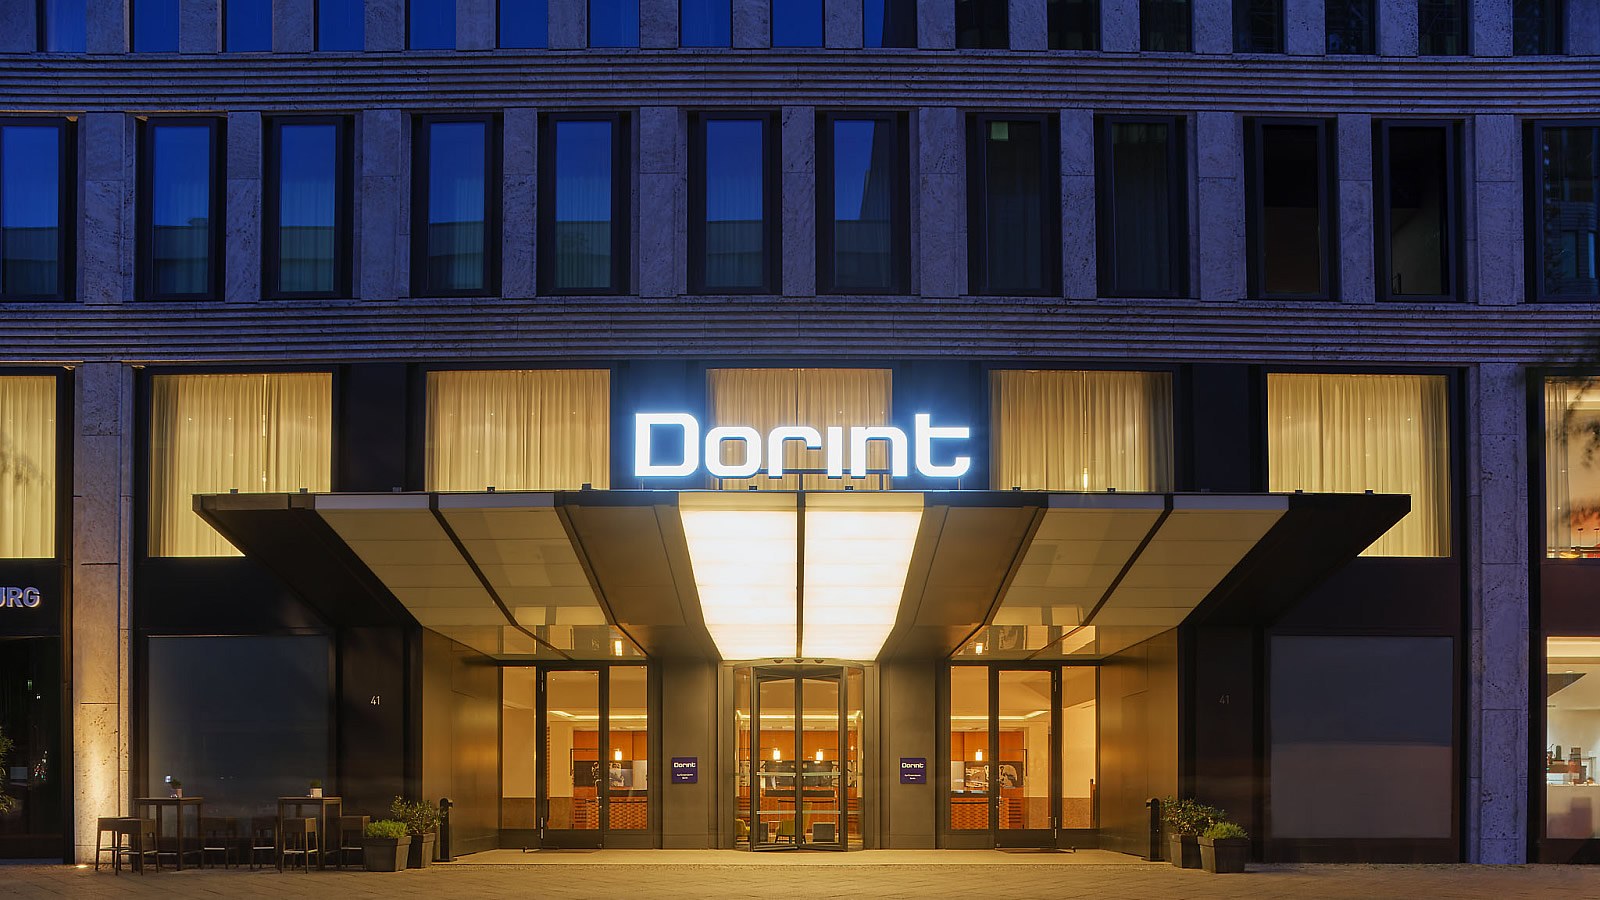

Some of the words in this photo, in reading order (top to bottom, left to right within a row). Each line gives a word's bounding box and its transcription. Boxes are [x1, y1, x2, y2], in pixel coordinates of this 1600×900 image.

[634, 412, 971, 479] Dorint
[370, 695, 380, 705] 41
[1219, 695, 1230, 704] 41
